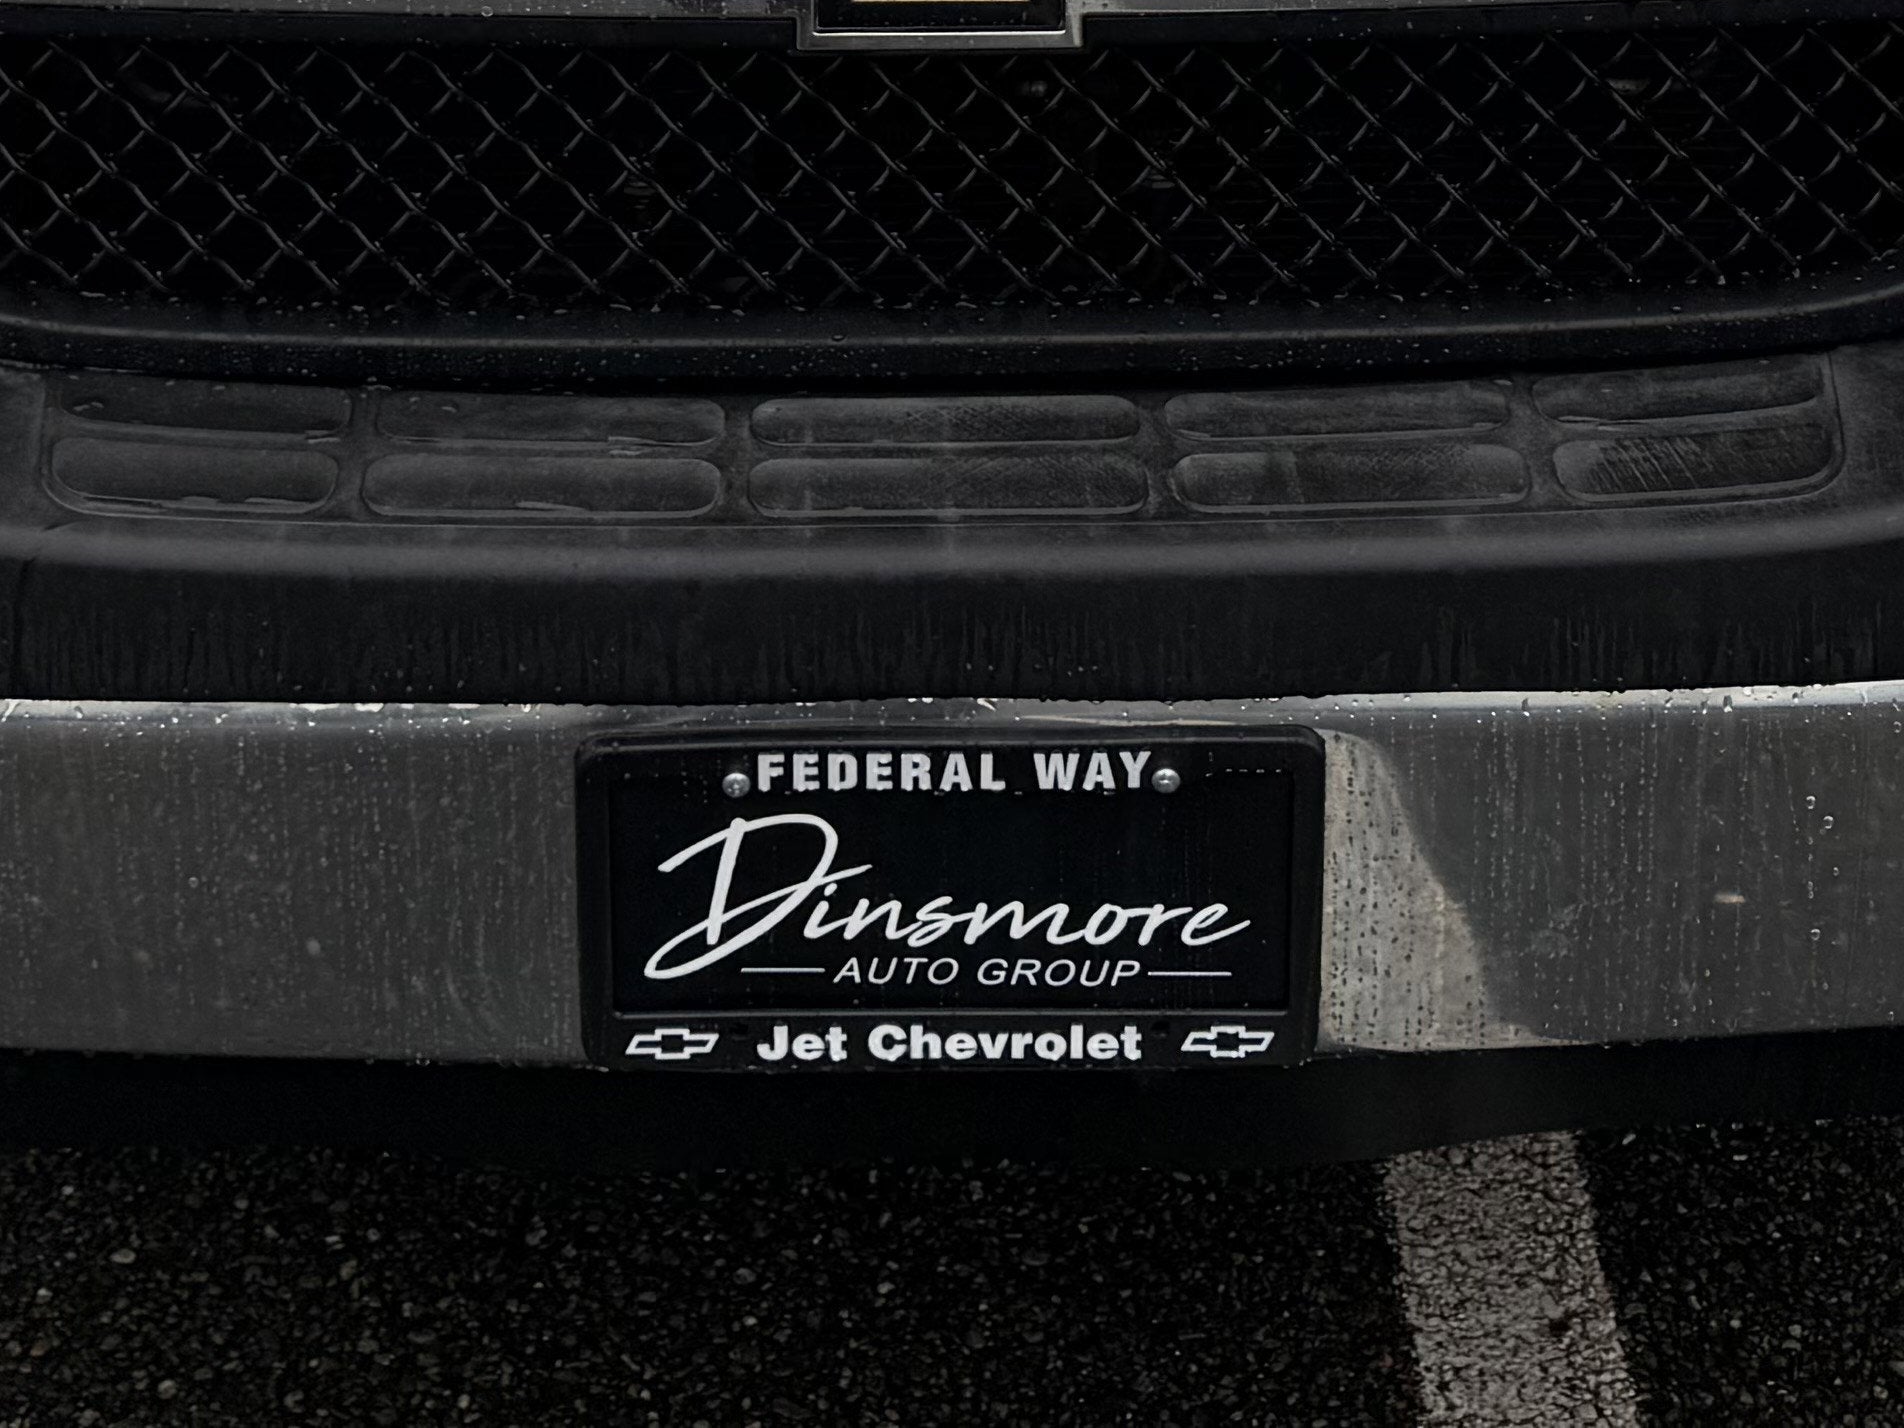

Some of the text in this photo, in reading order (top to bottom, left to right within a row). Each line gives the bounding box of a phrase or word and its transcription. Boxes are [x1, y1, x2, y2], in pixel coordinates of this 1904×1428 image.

[756, 749, 1153, 794] FEDERAL WAY
[643, 812, 1251, 981] Dinsmore
[832, 955, 1141, 988] AUTO GROUP
[755, 1022, 1143, 1063] Jet Chevrolet
